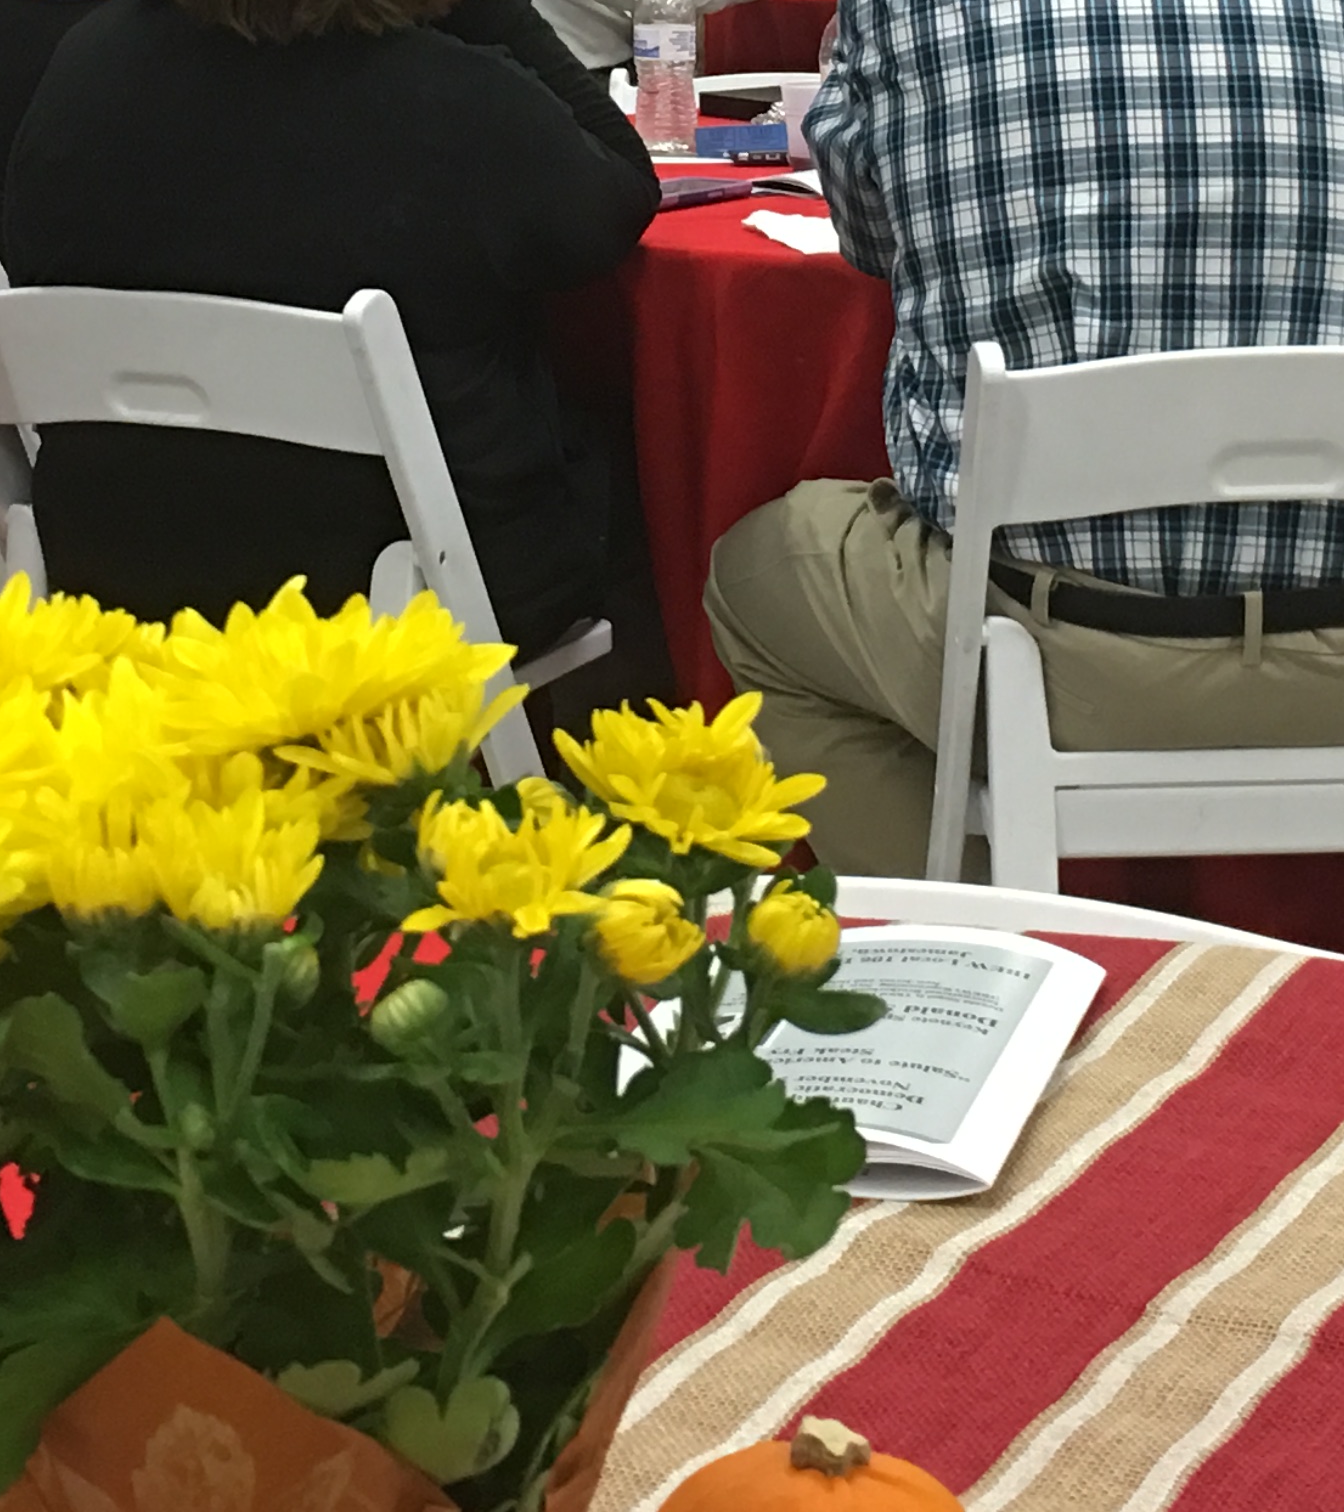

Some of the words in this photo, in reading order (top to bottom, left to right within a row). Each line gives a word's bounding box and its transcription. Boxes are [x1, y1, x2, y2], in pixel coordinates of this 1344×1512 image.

[902, 955, 958, 966] Local
[903, 1005, 998, 1028] Donald
[911, 1017, 988, 1036] Keynote
[814, 1047, 875, 1056] Steak
[767, 1056, 855, 1065] Americ
[860, 1058, 882, 1066] to
[794, 1076, 911, 1091] November
[794, 1085, 925, 1105] Democratic
